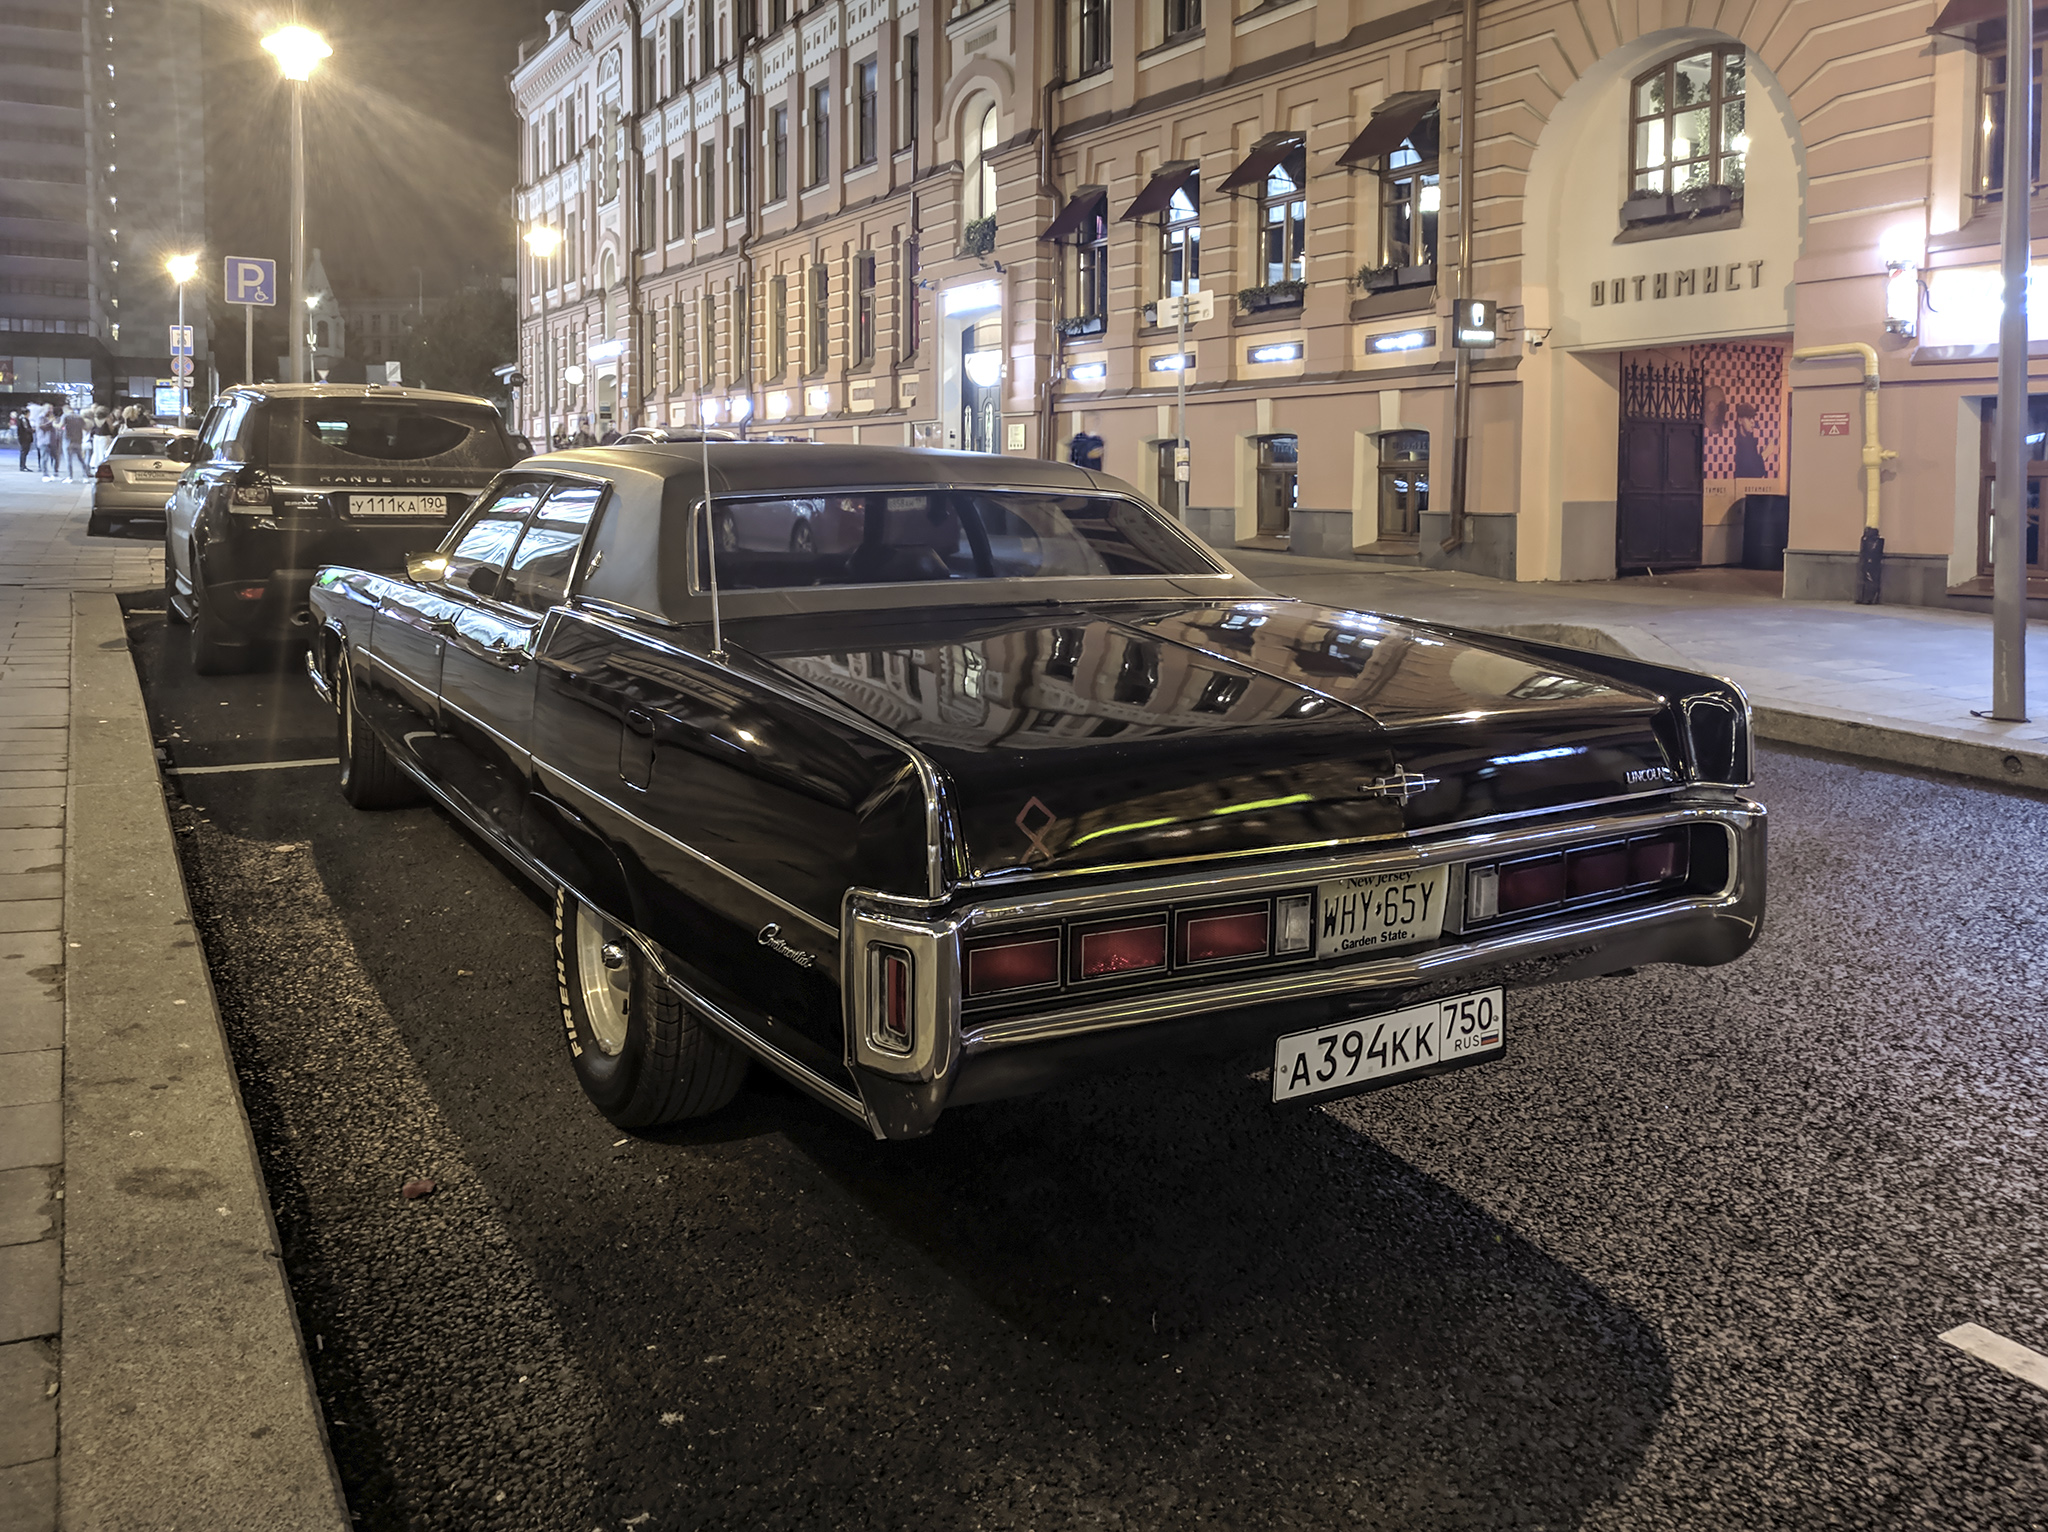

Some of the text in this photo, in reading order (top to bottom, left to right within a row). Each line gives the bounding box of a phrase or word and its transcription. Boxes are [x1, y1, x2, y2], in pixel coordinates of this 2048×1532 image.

[1590, 260, 1763, 307] ОПТИМИСТ
[320, 475, 392, 483] RANGE
[420, 497, 442, 508] 190
[1346, 870, 1413, 889] New Jersey
[1341, 929, 1408, 950] Garden State
[1443, 997, 1493, 1040] 750
[1454, 1034, 1480, 1052] RUS
